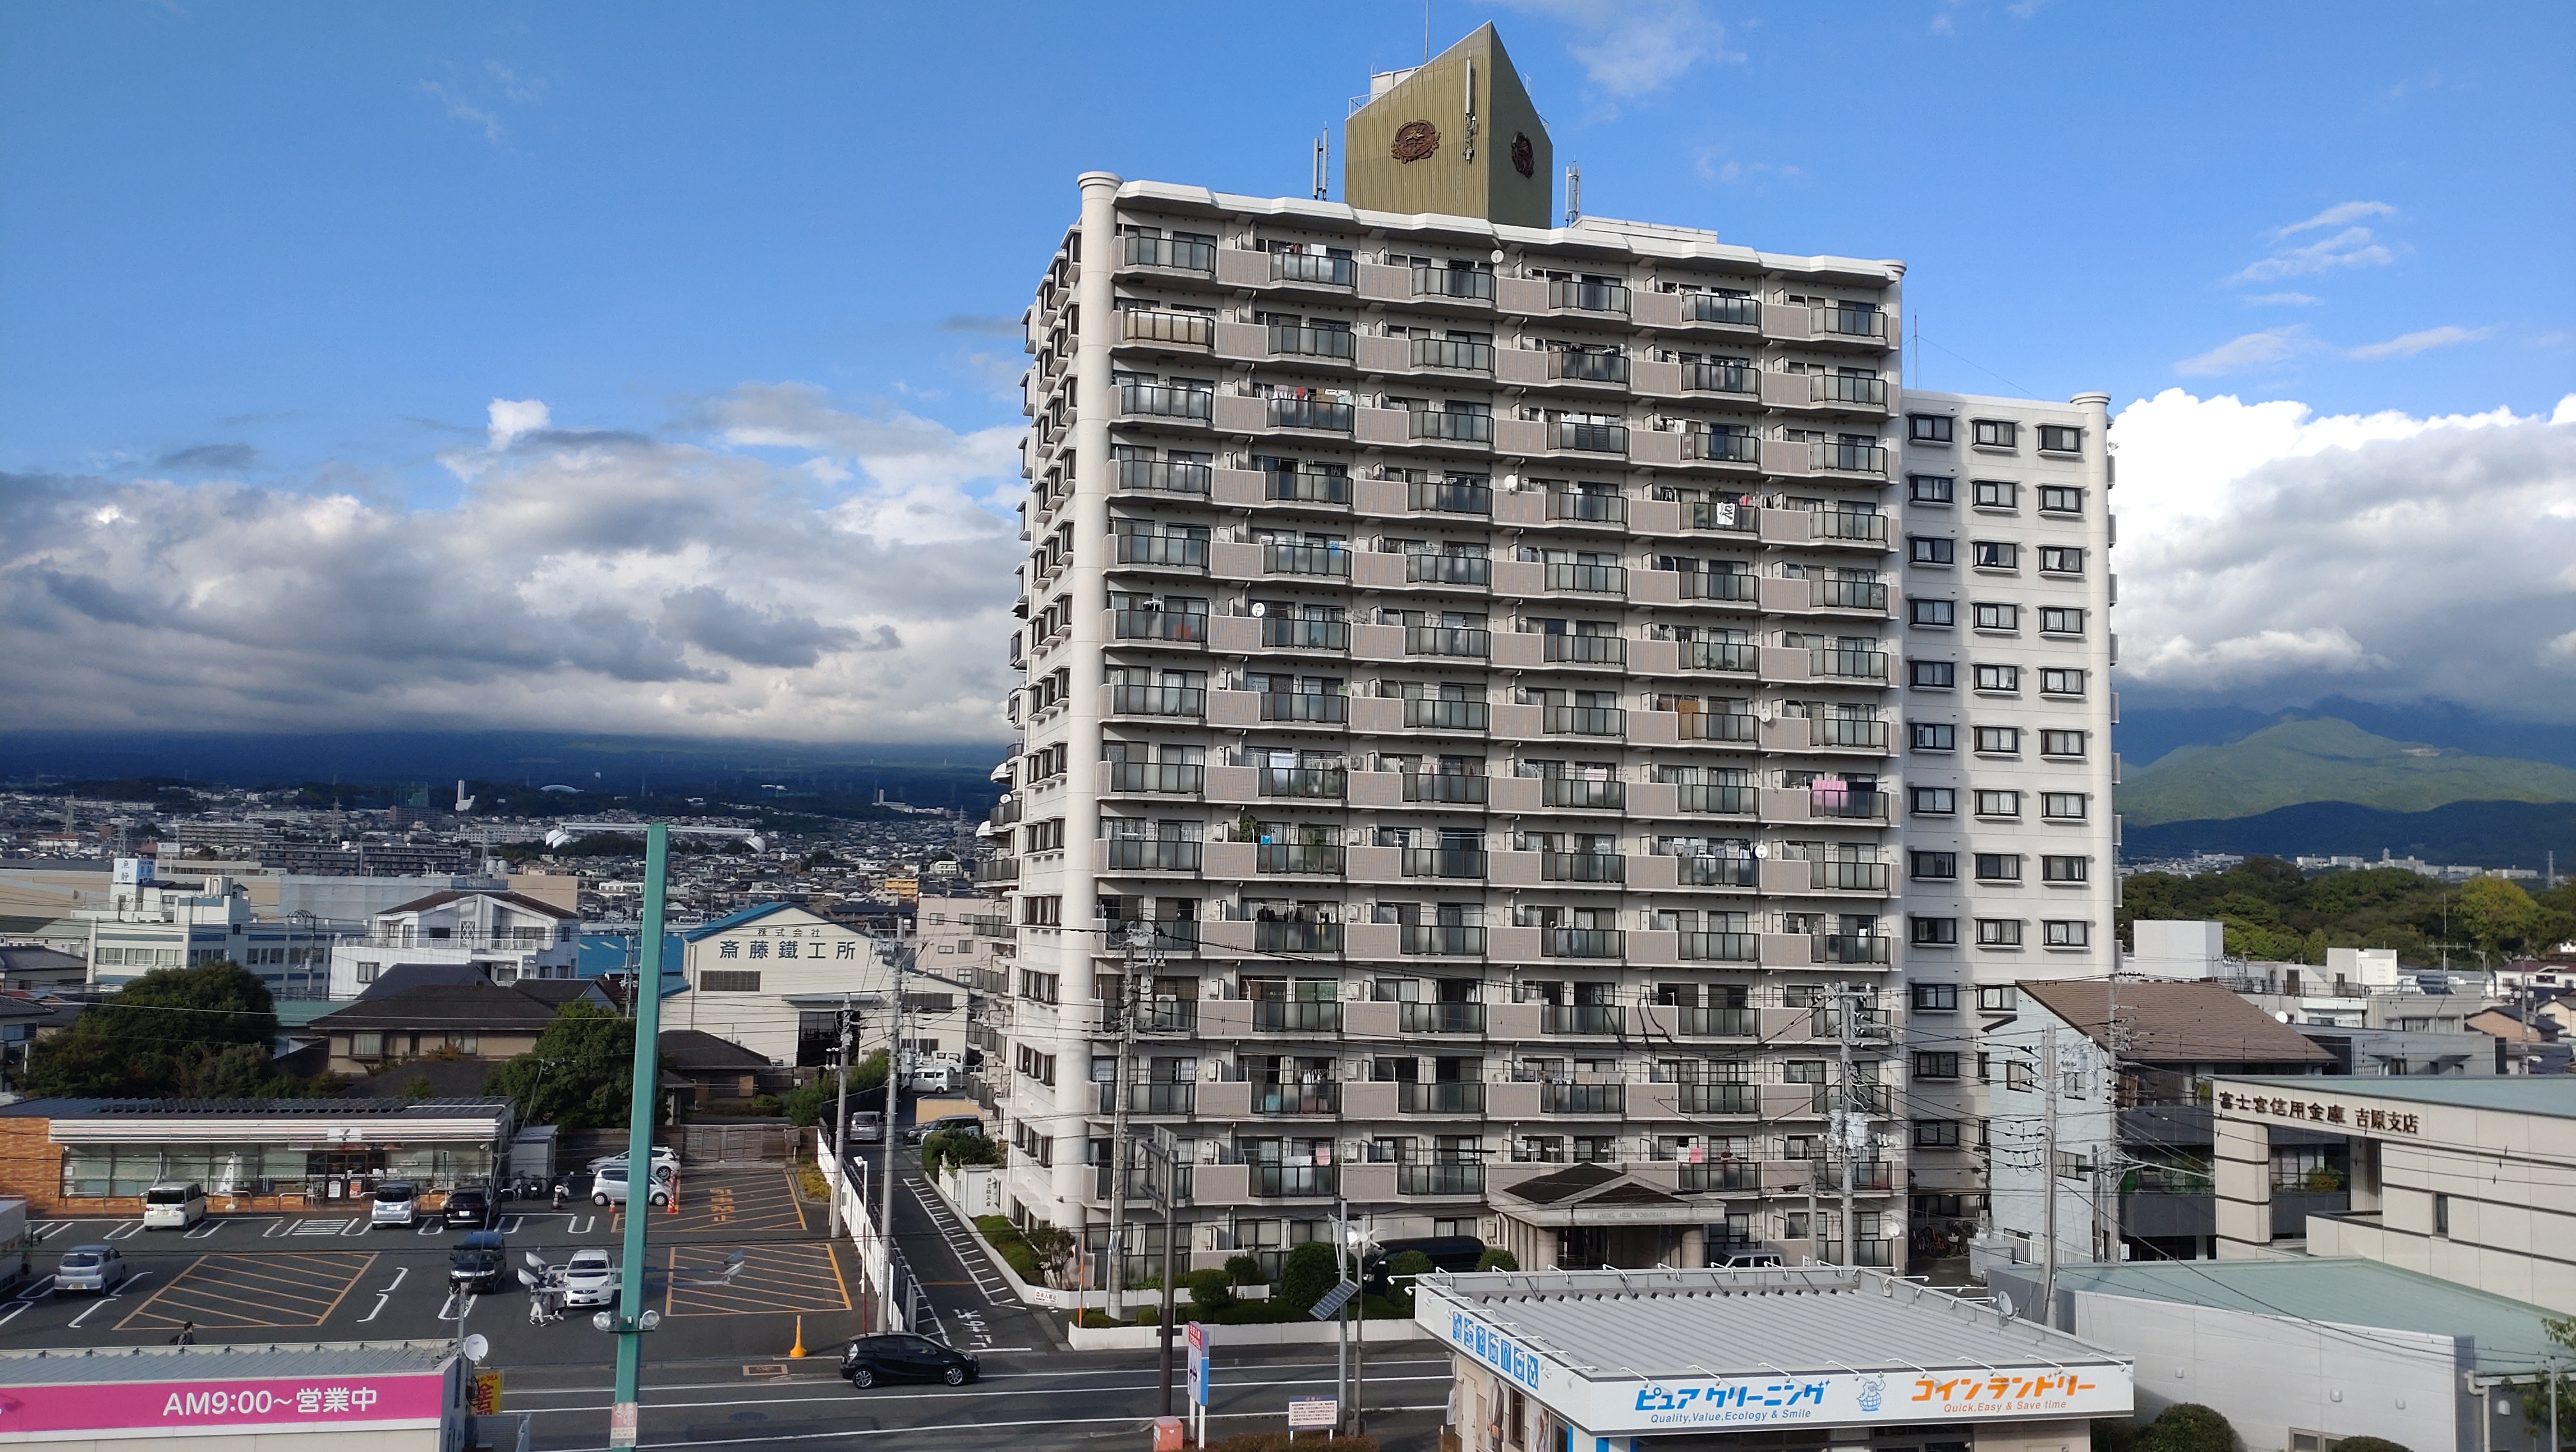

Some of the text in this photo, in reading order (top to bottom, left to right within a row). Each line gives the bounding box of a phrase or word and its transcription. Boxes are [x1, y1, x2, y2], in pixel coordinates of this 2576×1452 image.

[757, 928, 820, 938] 株式会社
[2219, 1091, 2419, 1134] 富士宮信用金庫 吉原支店
[1944, 1403, 2002, 1413] Quick,Easy
[2016, 1401, 2041, 1410] Save
[2044, 1400, 2067, 1409] time
[1782, 1409, 1811, 1418] Smile
